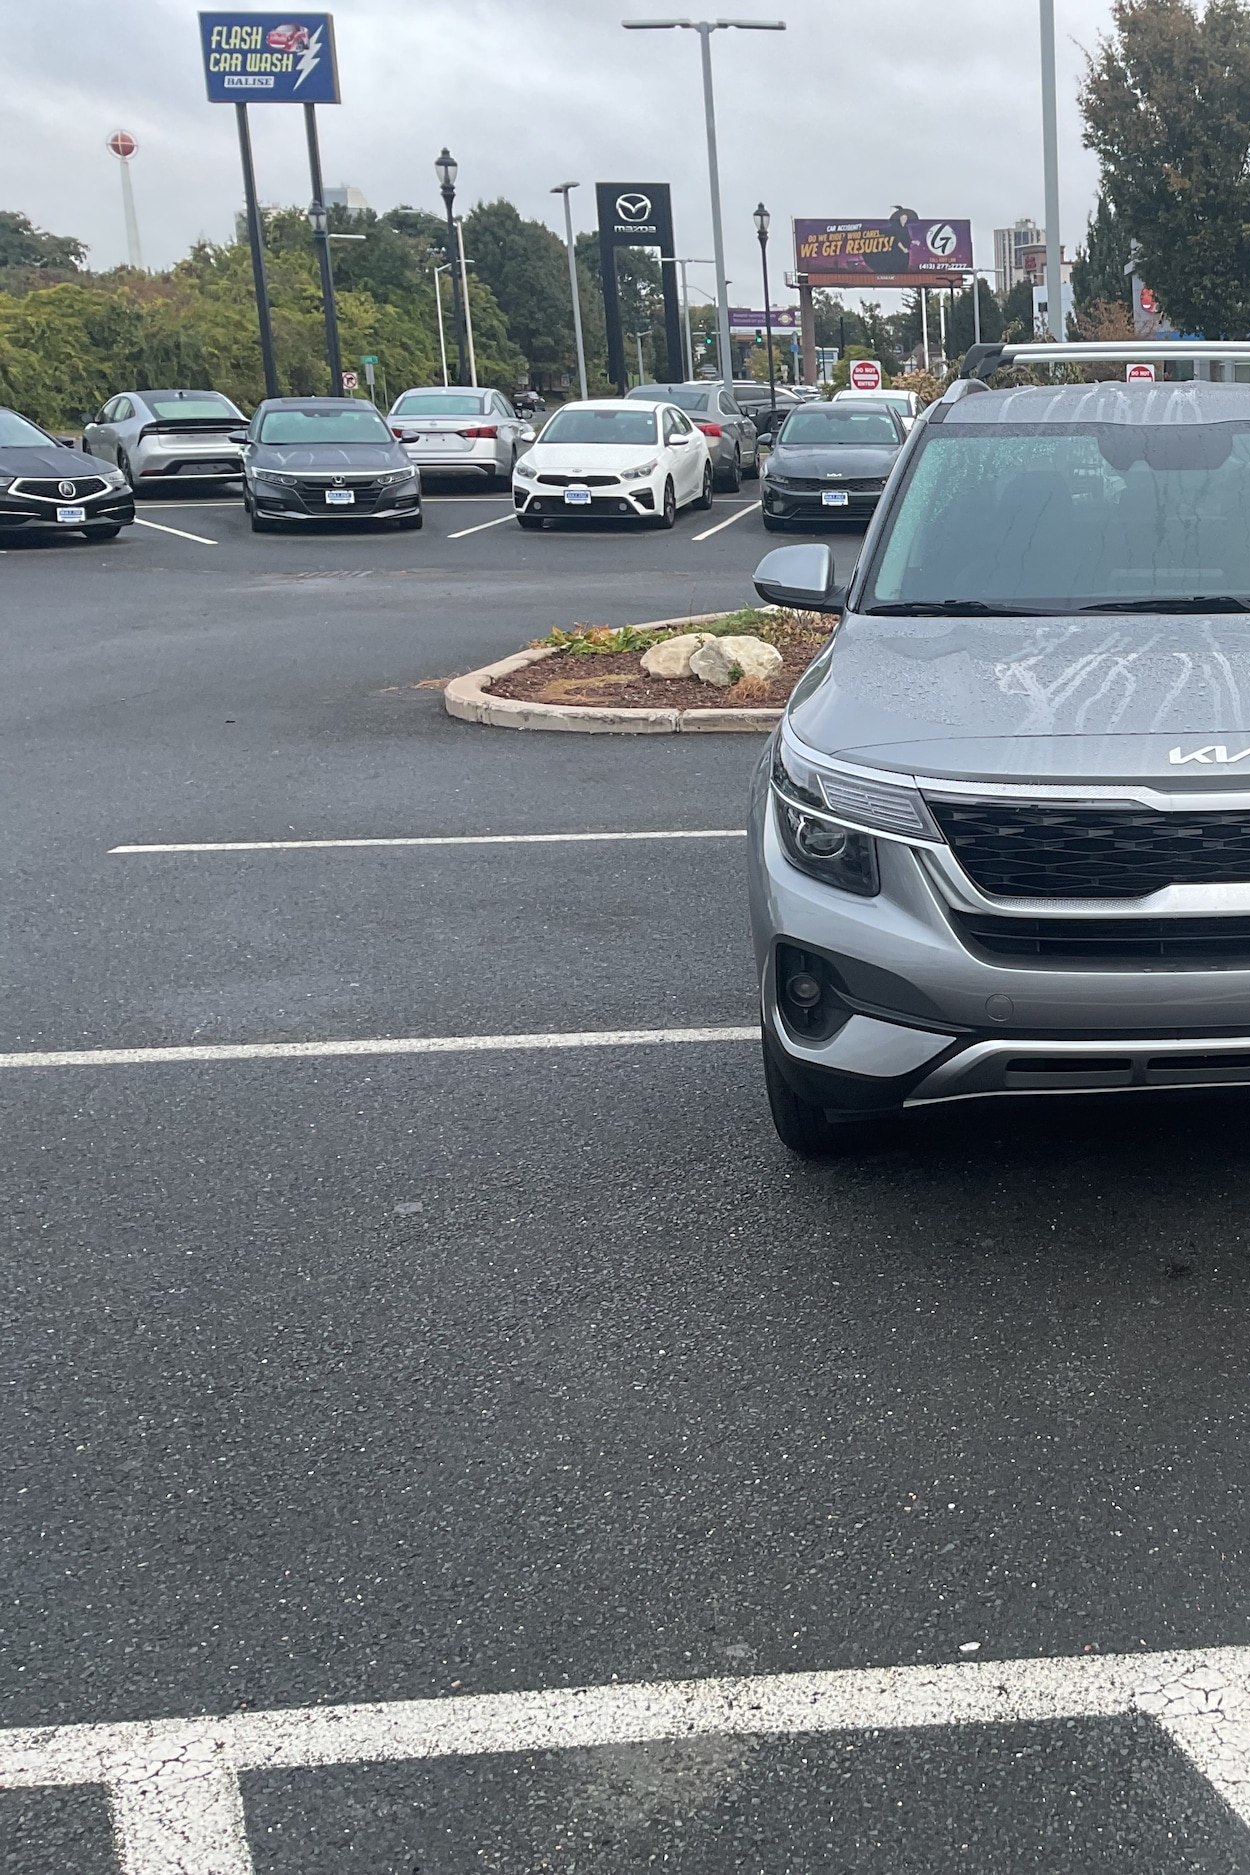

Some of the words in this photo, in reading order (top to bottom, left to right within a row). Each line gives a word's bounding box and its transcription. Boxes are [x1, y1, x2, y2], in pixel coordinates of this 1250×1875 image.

[211, 26, 262, 49] FLASH
[209, 53, 242, 72] CAR
[246, 53, 294, 72] WASH
[226, 77, 273, 86] BALISE
[837, 223, 862, 232] ACCIDENT?
[808, 235, 816, 243] DO
[818, 234, 828, 242] WE
[847, 231, 861, 240] WHO
[801, 243, 819, 258] WE
[822, 240, 843, 257] GET
[845, 236, 895, 254] RESULTS!
